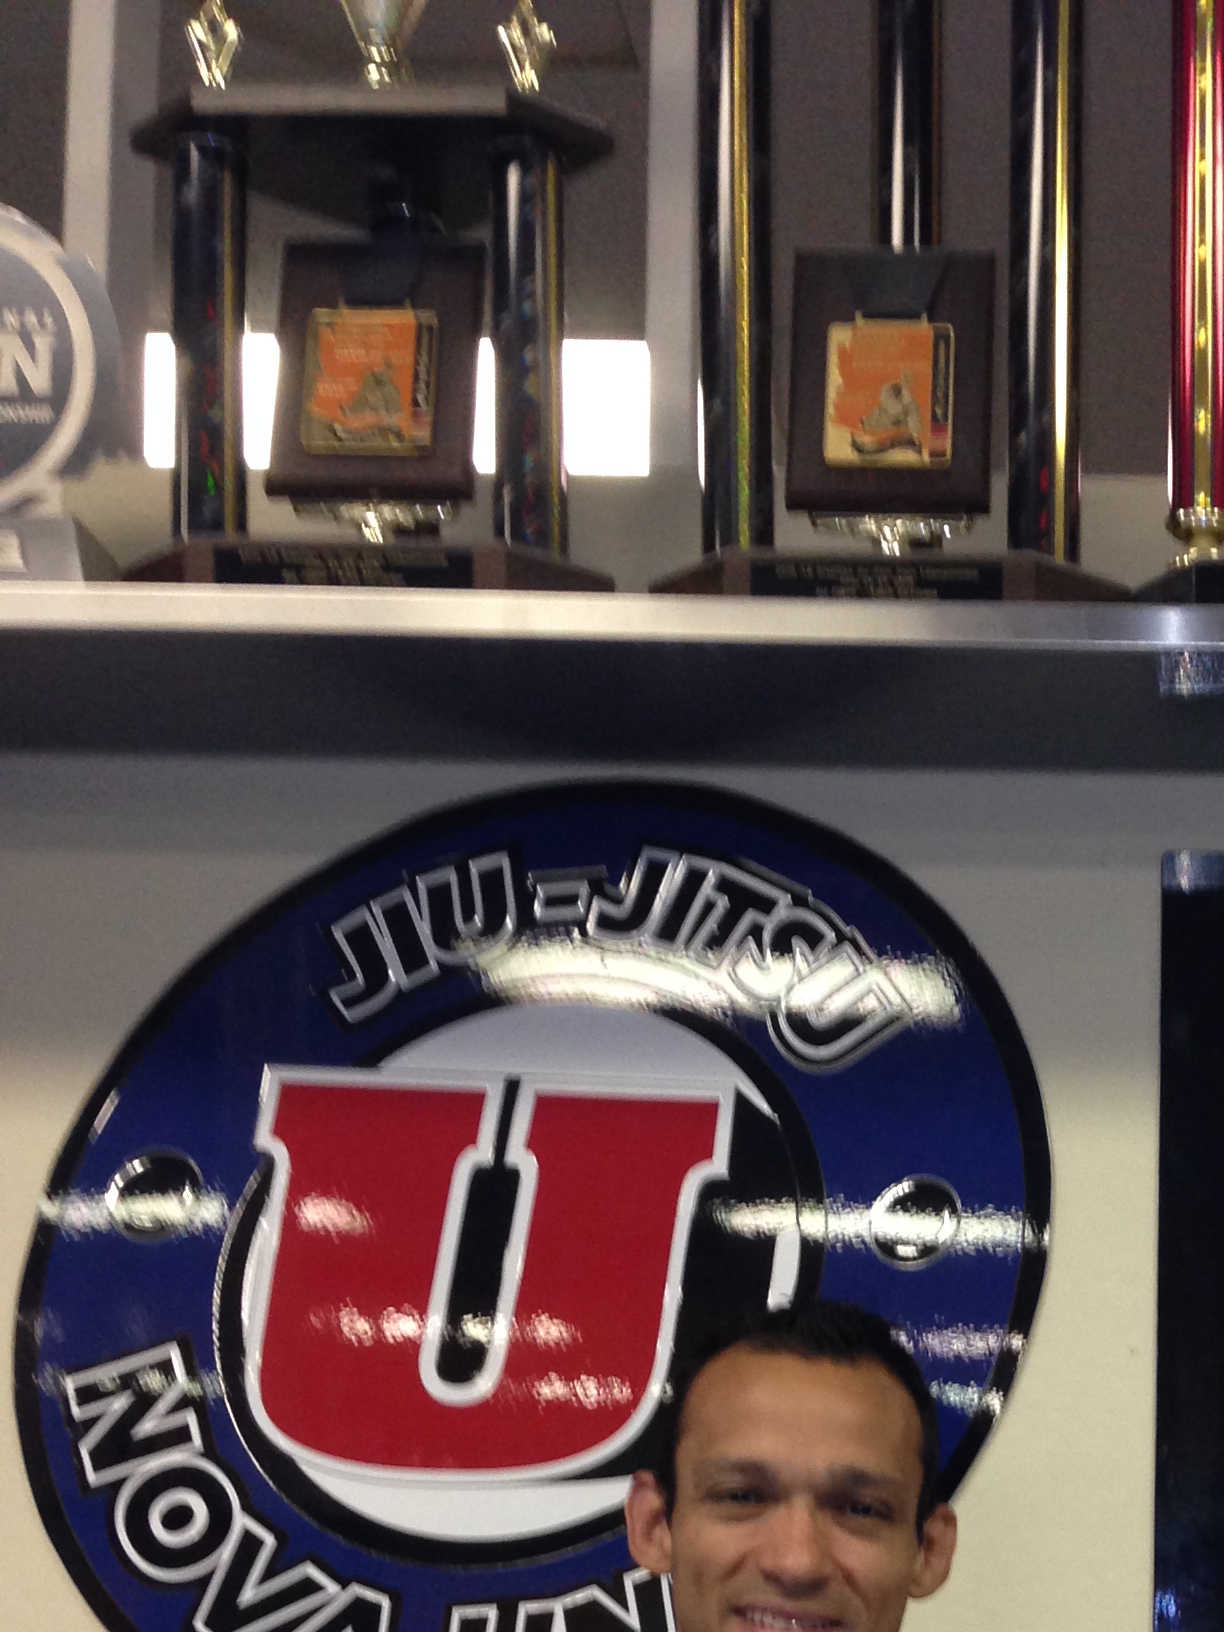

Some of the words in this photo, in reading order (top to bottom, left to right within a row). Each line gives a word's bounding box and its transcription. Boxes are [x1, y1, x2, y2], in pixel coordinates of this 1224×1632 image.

[0, 330, 54, 398] N
[327, 845, 912, 1072] JIU-JITSU
[256, 1064, 738, 1481] U
